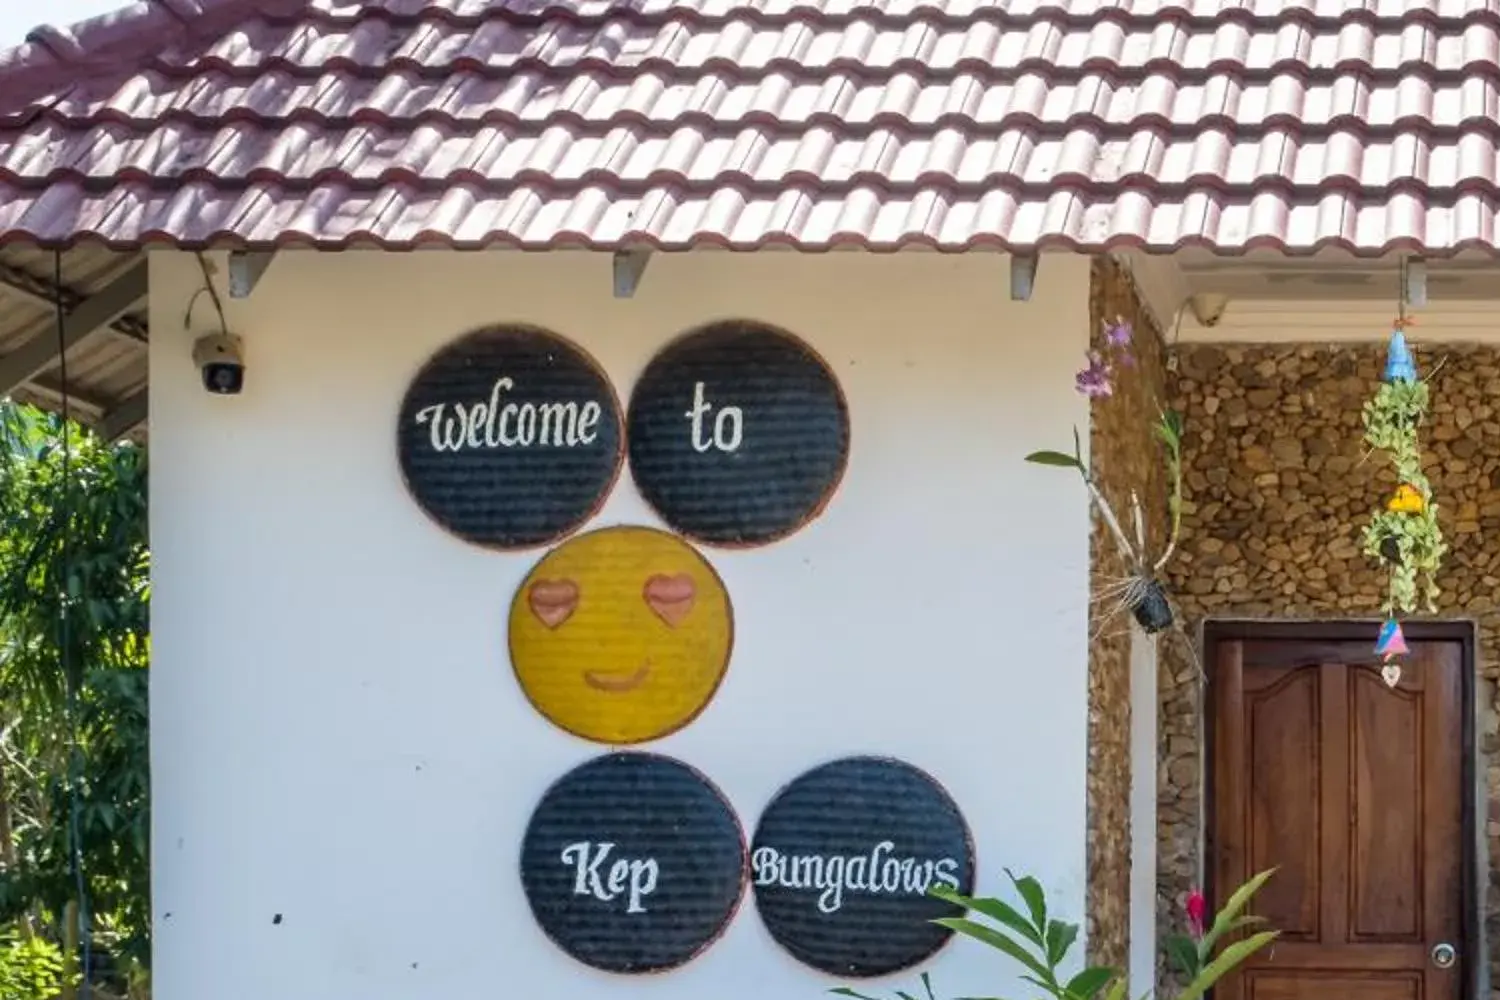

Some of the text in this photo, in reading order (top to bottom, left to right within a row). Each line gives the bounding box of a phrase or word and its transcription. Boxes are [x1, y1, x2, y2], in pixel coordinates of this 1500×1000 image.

[684, 381, 744, 453] to
[560, 840, 961, 914] Kep Bungalows
